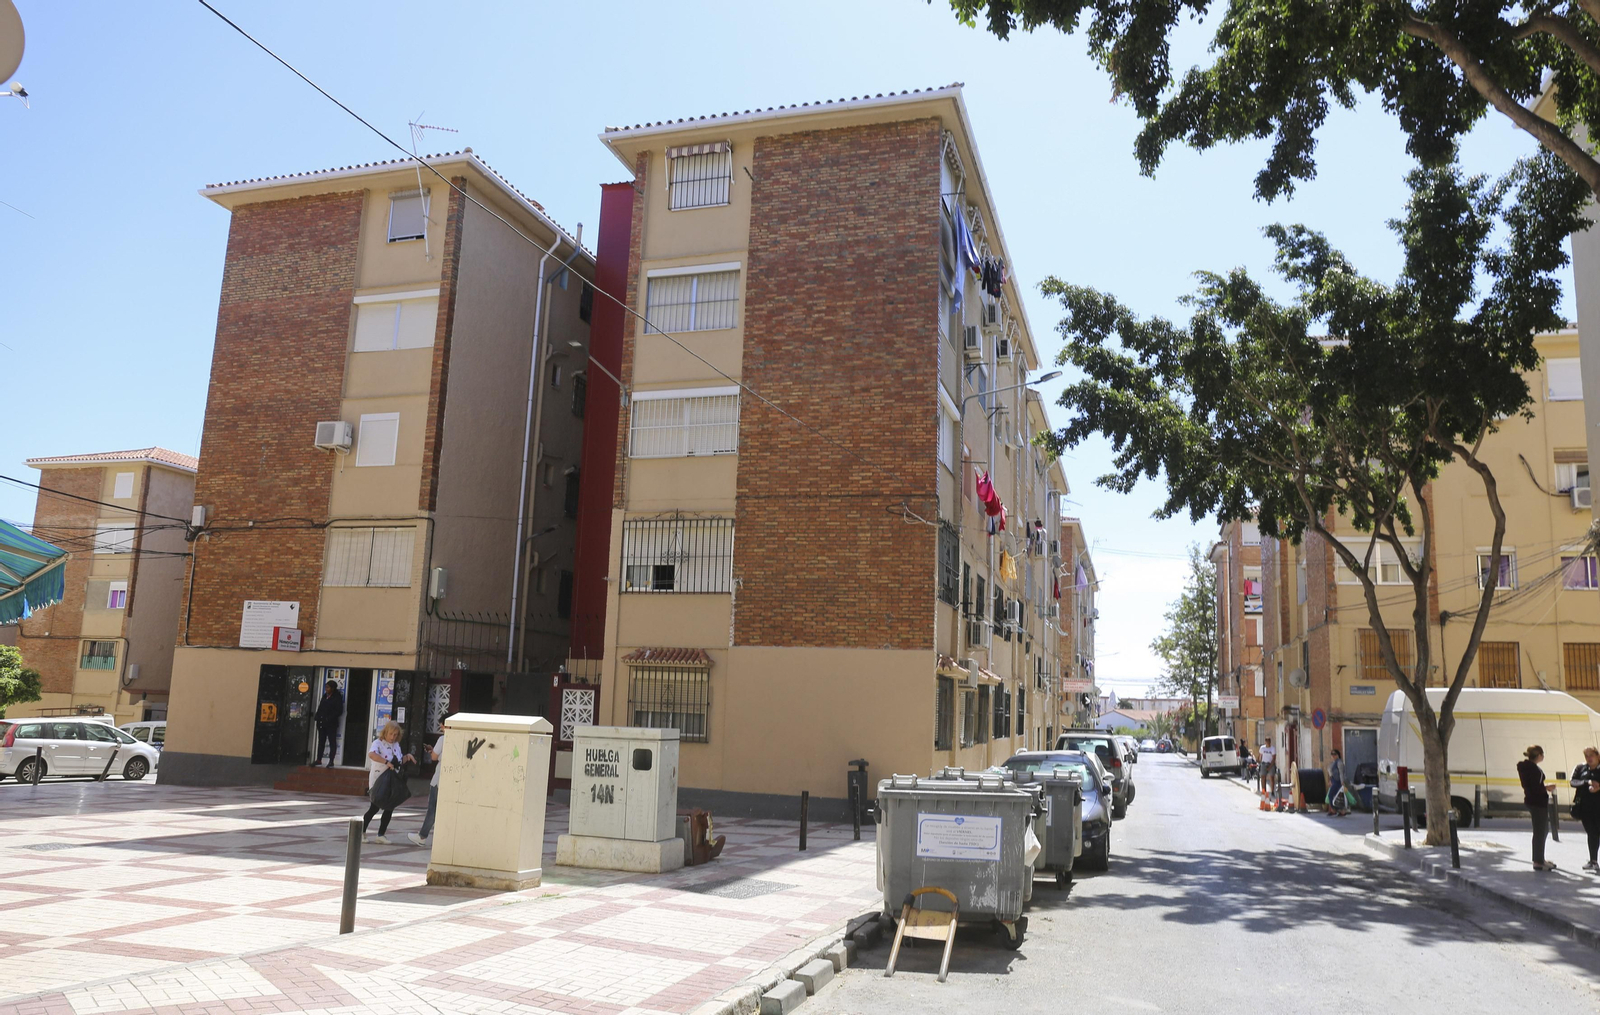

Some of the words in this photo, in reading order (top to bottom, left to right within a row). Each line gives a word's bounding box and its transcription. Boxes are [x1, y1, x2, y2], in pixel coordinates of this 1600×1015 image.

[585, 748, 620, 763] HUELGA
[584, 763, 619, 778] GENERAL
[590, 783, 614, 805] 14N
